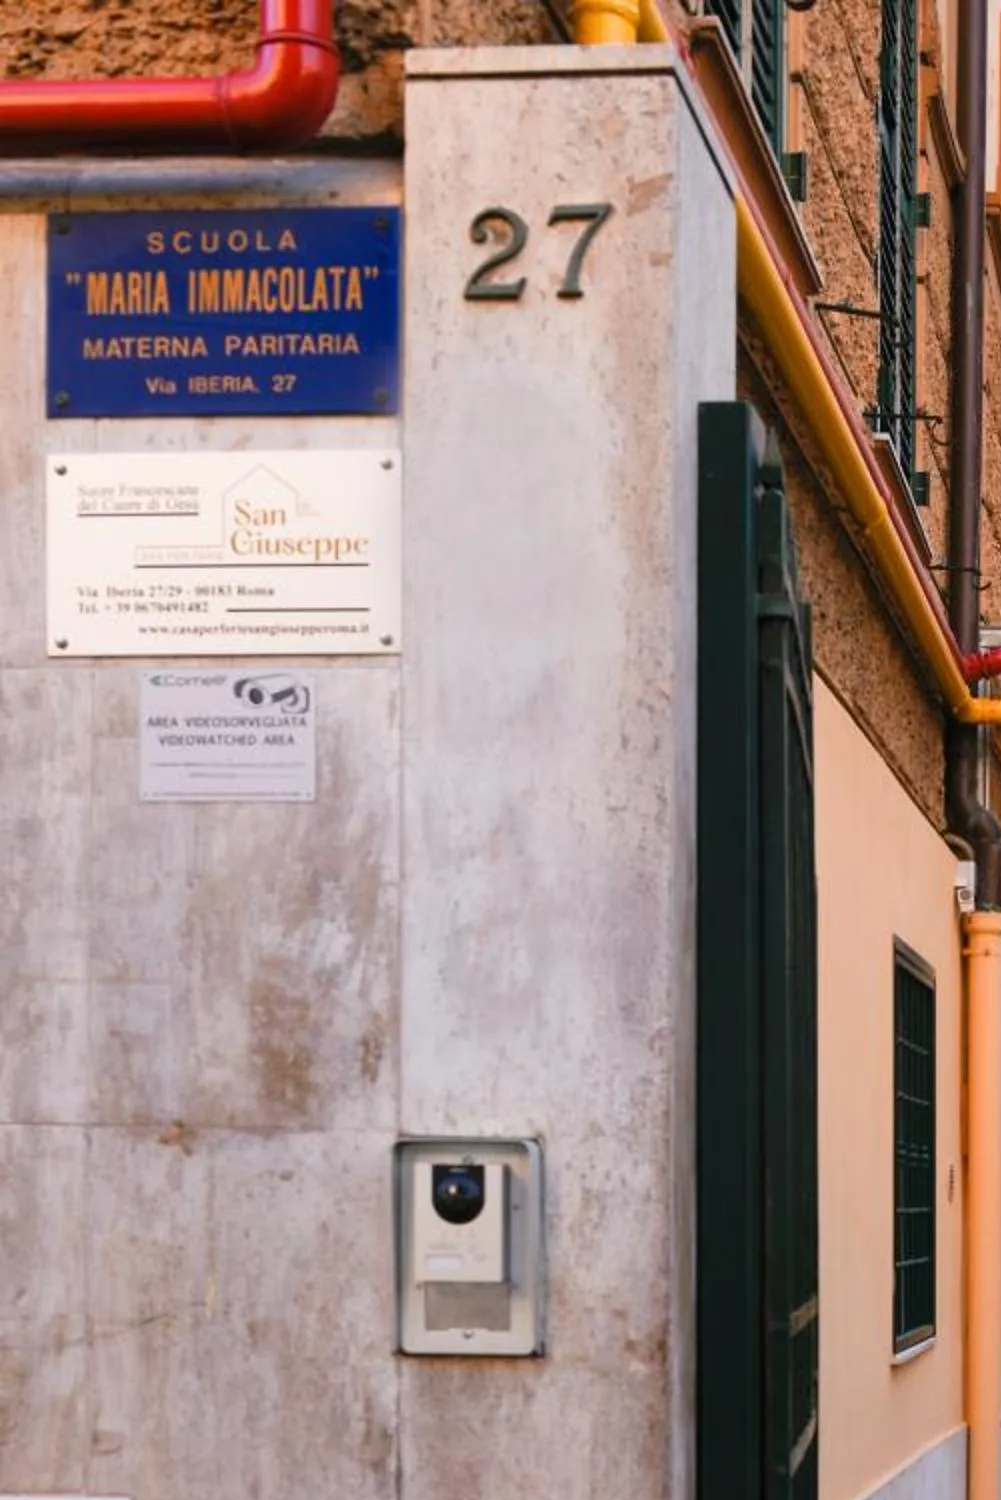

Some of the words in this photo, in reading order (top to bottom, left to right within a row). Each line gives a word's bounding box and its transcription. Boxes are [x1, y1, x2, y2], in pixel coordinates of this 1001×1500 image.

[146, 229, 297, 254] SCUOLA
[463, 203, 616, 302] 27
[66, 271, 170, 315] "MARIA
[188, 265, 379, 313] IMMACOLATA"
[83, 336, 208, 360] MATERNA
[225, 333, 360, 356] PARITARIA
[145, 377, 177, 394] Via
[272, 374, 297, 392] 27
[234, 499, 286, 526] San
[230, 529, 369, 561] Giuseppe
[237, 584, 275, 596] Roma
[147, 717, 179, 728] AREA
[185, 716, 307, 728] VIDEOSORVEGLIATA
[159, 734, 257, 746] VIDEOWATCHED
[263, 734, 296, 746] AREA
